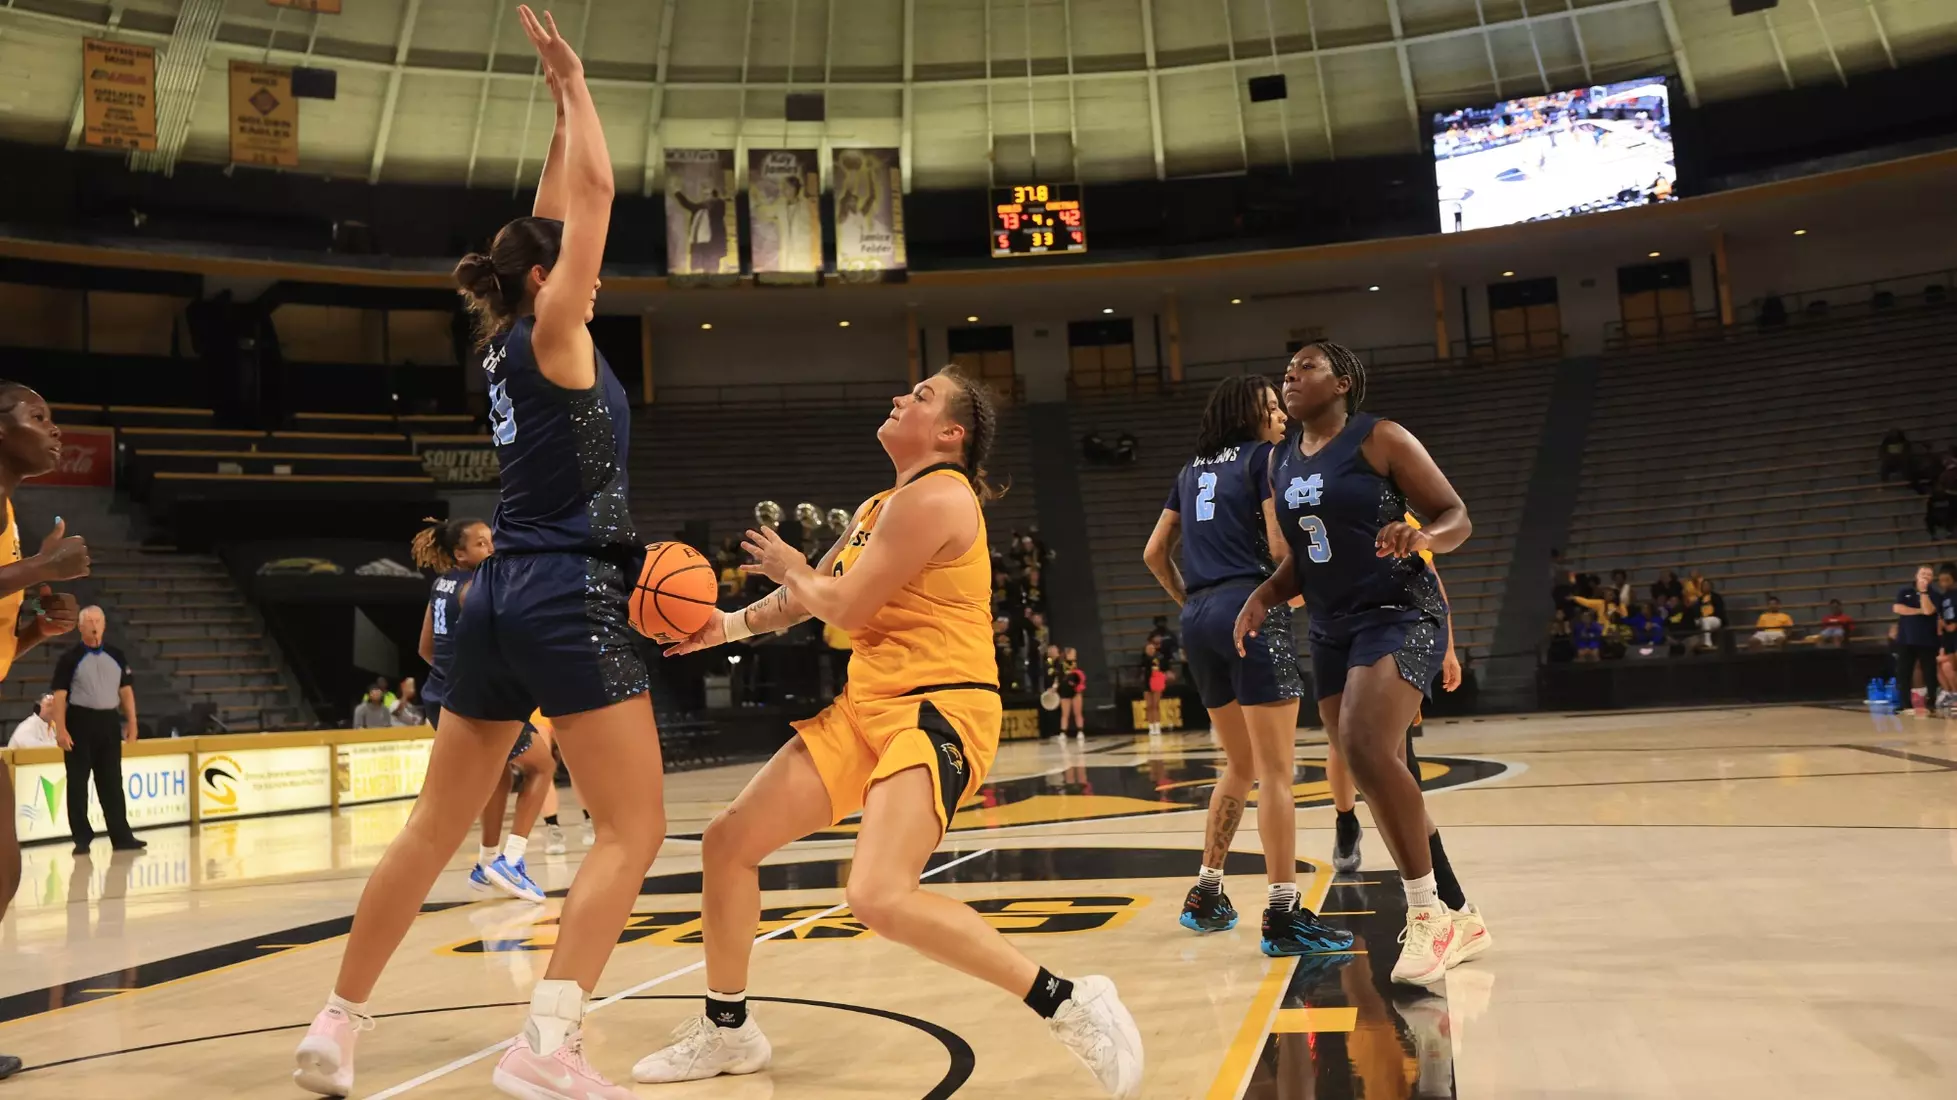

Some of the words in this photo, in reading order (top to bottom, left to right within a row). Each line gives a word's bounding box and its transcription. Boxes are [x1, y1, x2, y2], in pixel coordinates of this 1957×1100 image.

[771, 154, 793, 165] Kay
[764, 164, 799, 175] James
[999, 213, 1020, 230] 73
[1059, 209, 1081, 226] 42
[859, 231, 890, 243] Janice
[998, 233, 1010, 249] 5
[1196, 472, 1217, 522] 2
[1298, 514, 1333, 563] 3
[128, 769, 186, 800] OUTH
